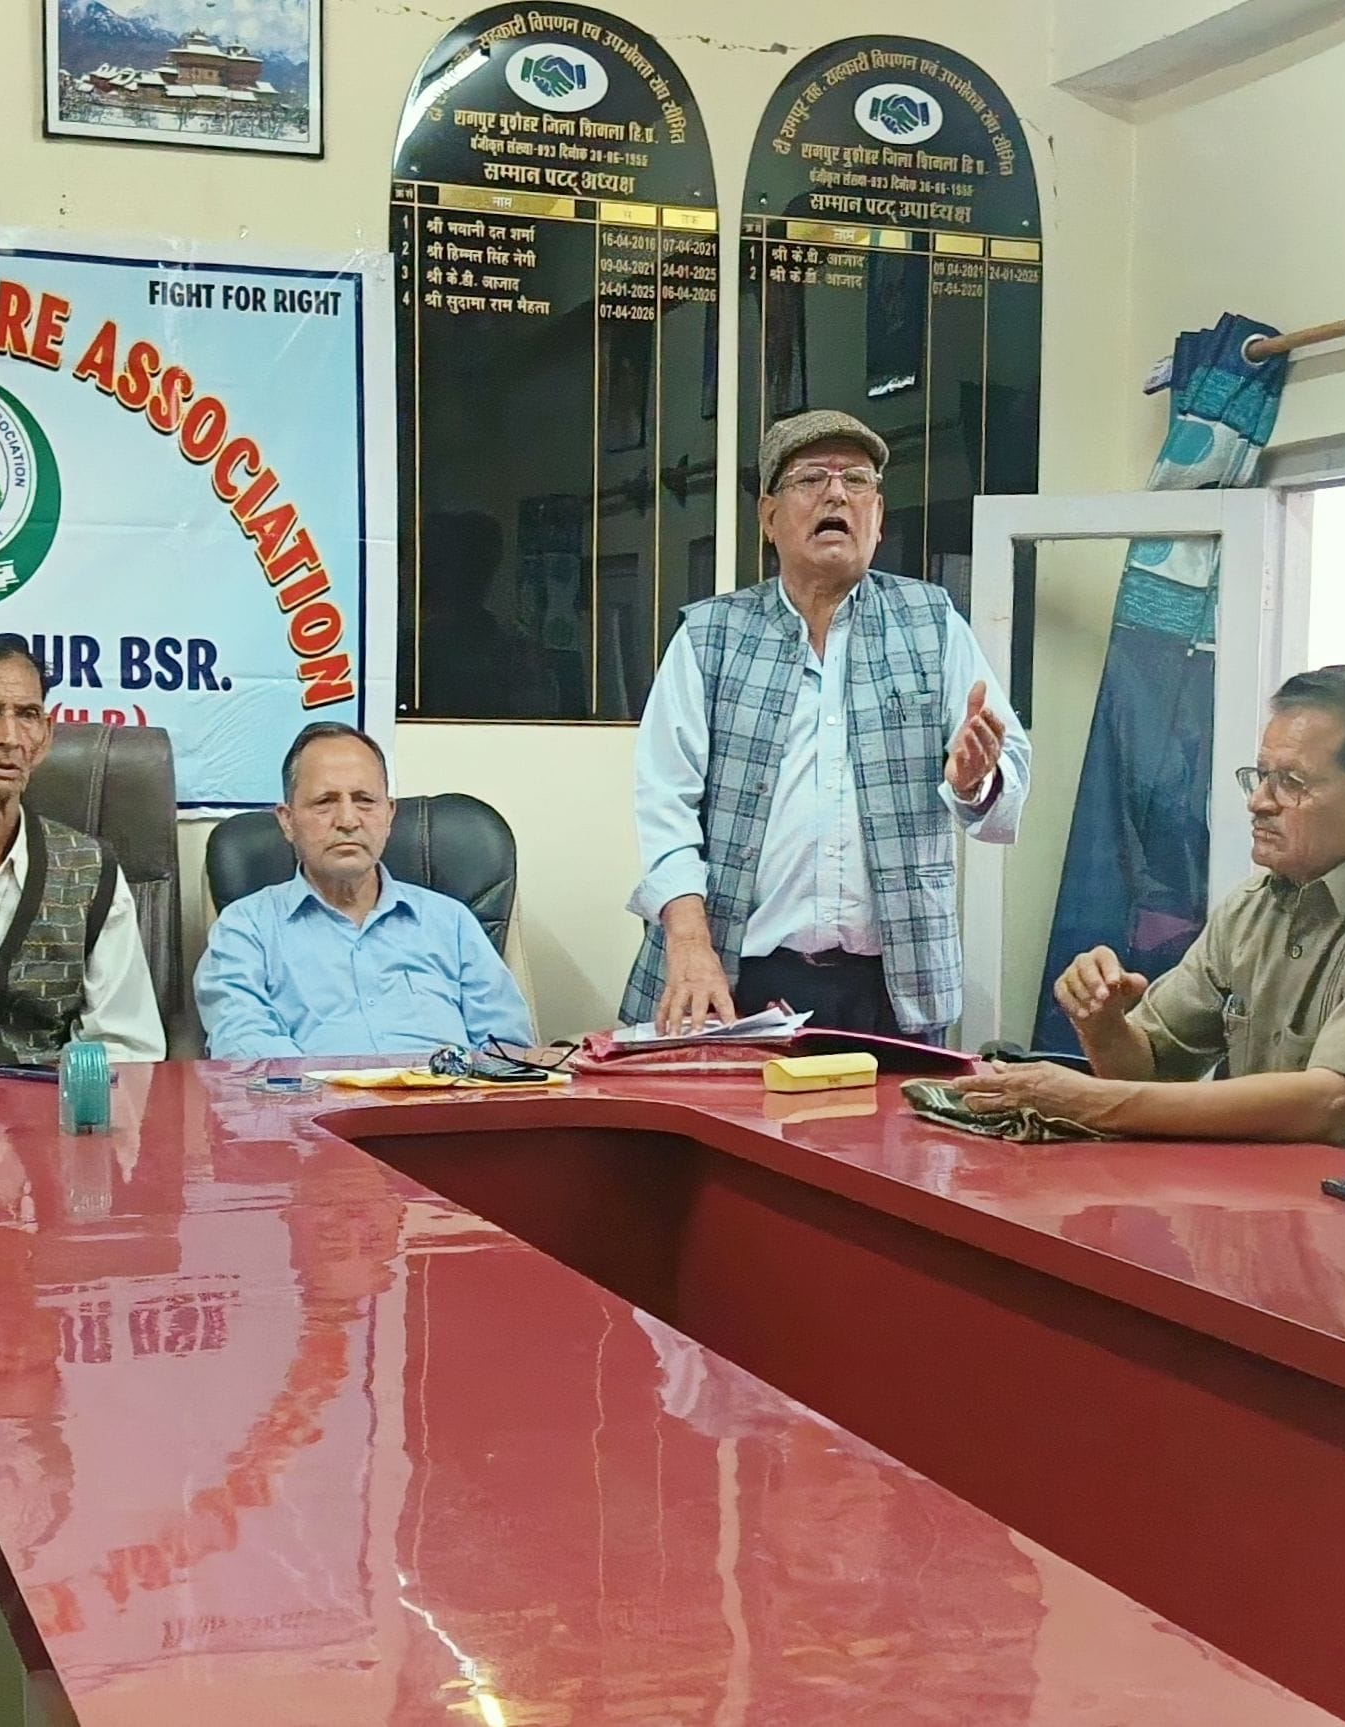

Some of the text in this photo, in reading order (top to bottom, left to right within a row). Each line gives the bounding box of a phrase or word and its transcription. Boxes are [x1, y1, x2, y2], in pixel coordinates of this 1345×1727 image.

[871, 49, 918, 71] विपणन
[454, 109, 496, 132] रामपुर
[542, 113, 575, 137] जिला
[579, 117, 625, 141] शिमला
[801, 143, 839, 166] रामपुर
[882, 147, 913, 169] जिला
[917, 150, 958, 172] शिमला
[483, 162, 541, 184] सम्मान
[581, 171, 636, 195] अध्यक्ष
[809, 193, 862, 213] सम्मान
[403, 215, 409, 229] 1
[426, 216, 443, 234] श्री
[447, 219, 485, 238] भवानी
[510, 224, 536, 242] शर्मा
[402, 241, 409, 256] 2
[426, 241, 536, 268] श्री हिम्मत सिंह नेगी
[663, 238, 717, 257] 07-04-2021
[750, 245, 755, 260] 1
[771, 245, 787, 262] श्री
[826, 253, 865, 268] आजाद
[401, 265, 408, 279] 3
[426, 266, 442, 285] श्री
[481, 275, 520, 291] आजाद
[662, 263, 717, 281] 24-01-2025
[749, 266, 756, 281] 2
[769, 265, 786, 282] श्री
[148, 280, 342, 316] FIGHT FOR RIGHT
[403, 291, 409, 306] 4
[600, 282, 655, 299] 24-01-2025
[424, 290, 442, 308] श्री
[446, 294, 486, 314] सुदामा
[489, 297, 513, 312] राम
[600, 304, 655, 320] 07-04-2026
[73, 320, 355, 711] ASSOCIATION
[120, 636, 233, 692] BSR.
